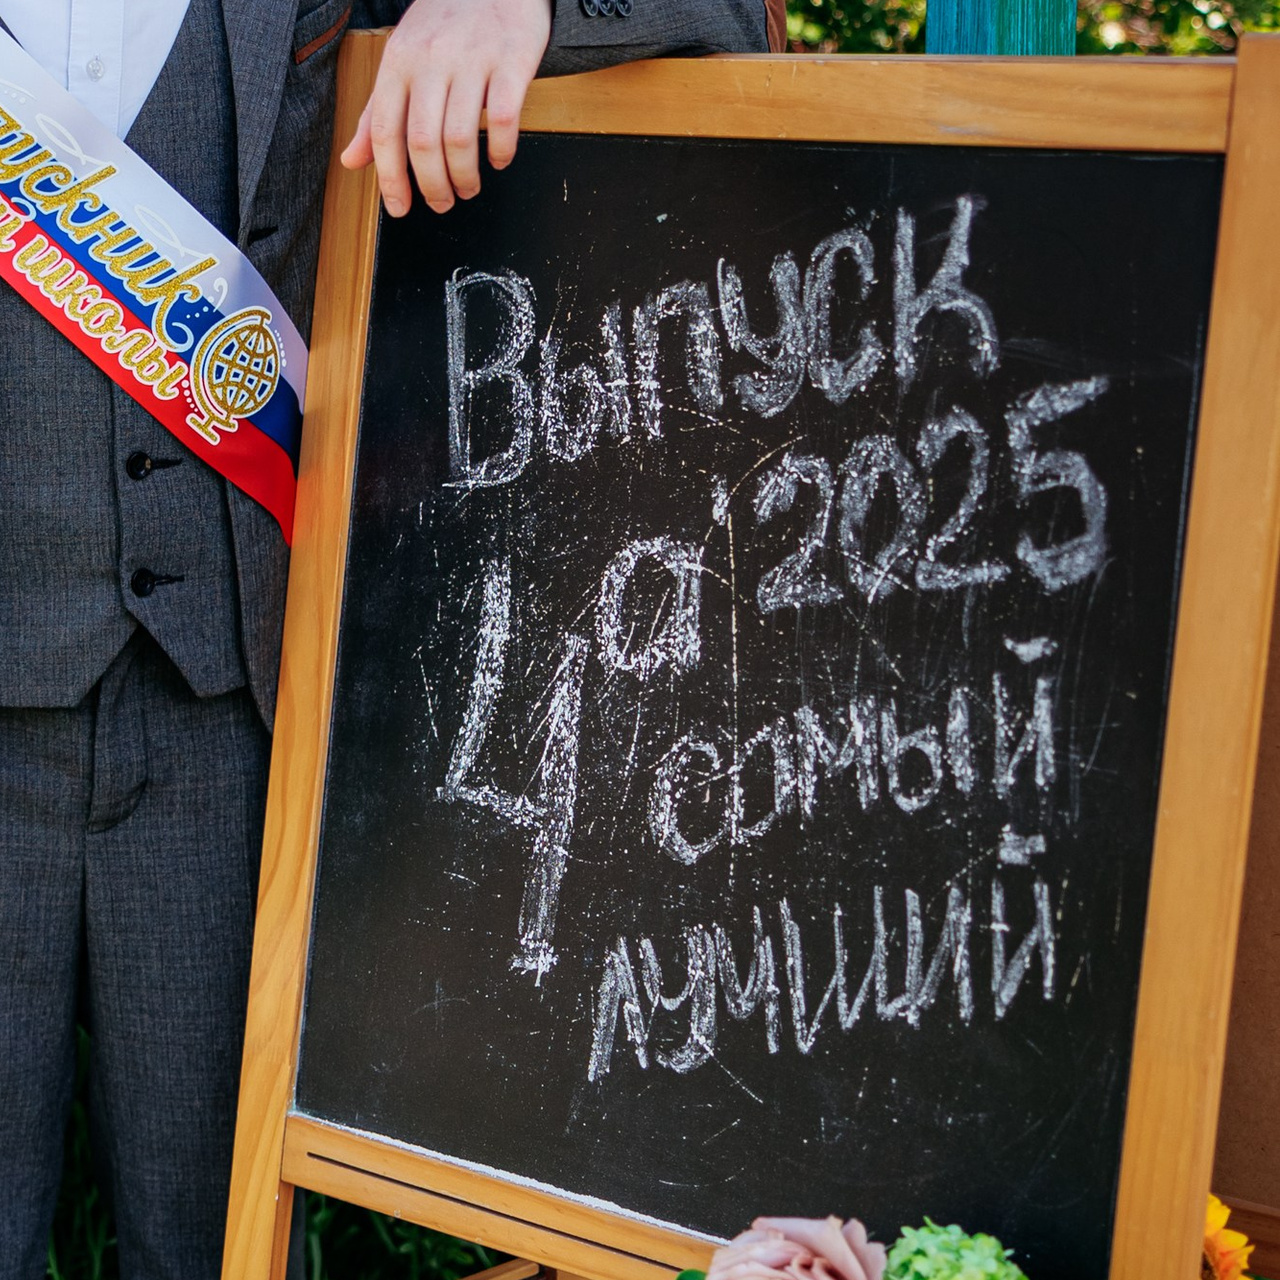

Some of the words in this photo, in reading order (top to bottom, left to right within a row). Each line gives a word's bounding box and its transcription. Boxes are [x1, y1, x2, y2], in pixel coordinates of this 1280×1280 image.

[16, 235, 189, 400] школы
[442, 196, 1000, 488] Выпуск
[754, 375, 1110, 614] 2025
[646, 635, 1060, 866] самый
